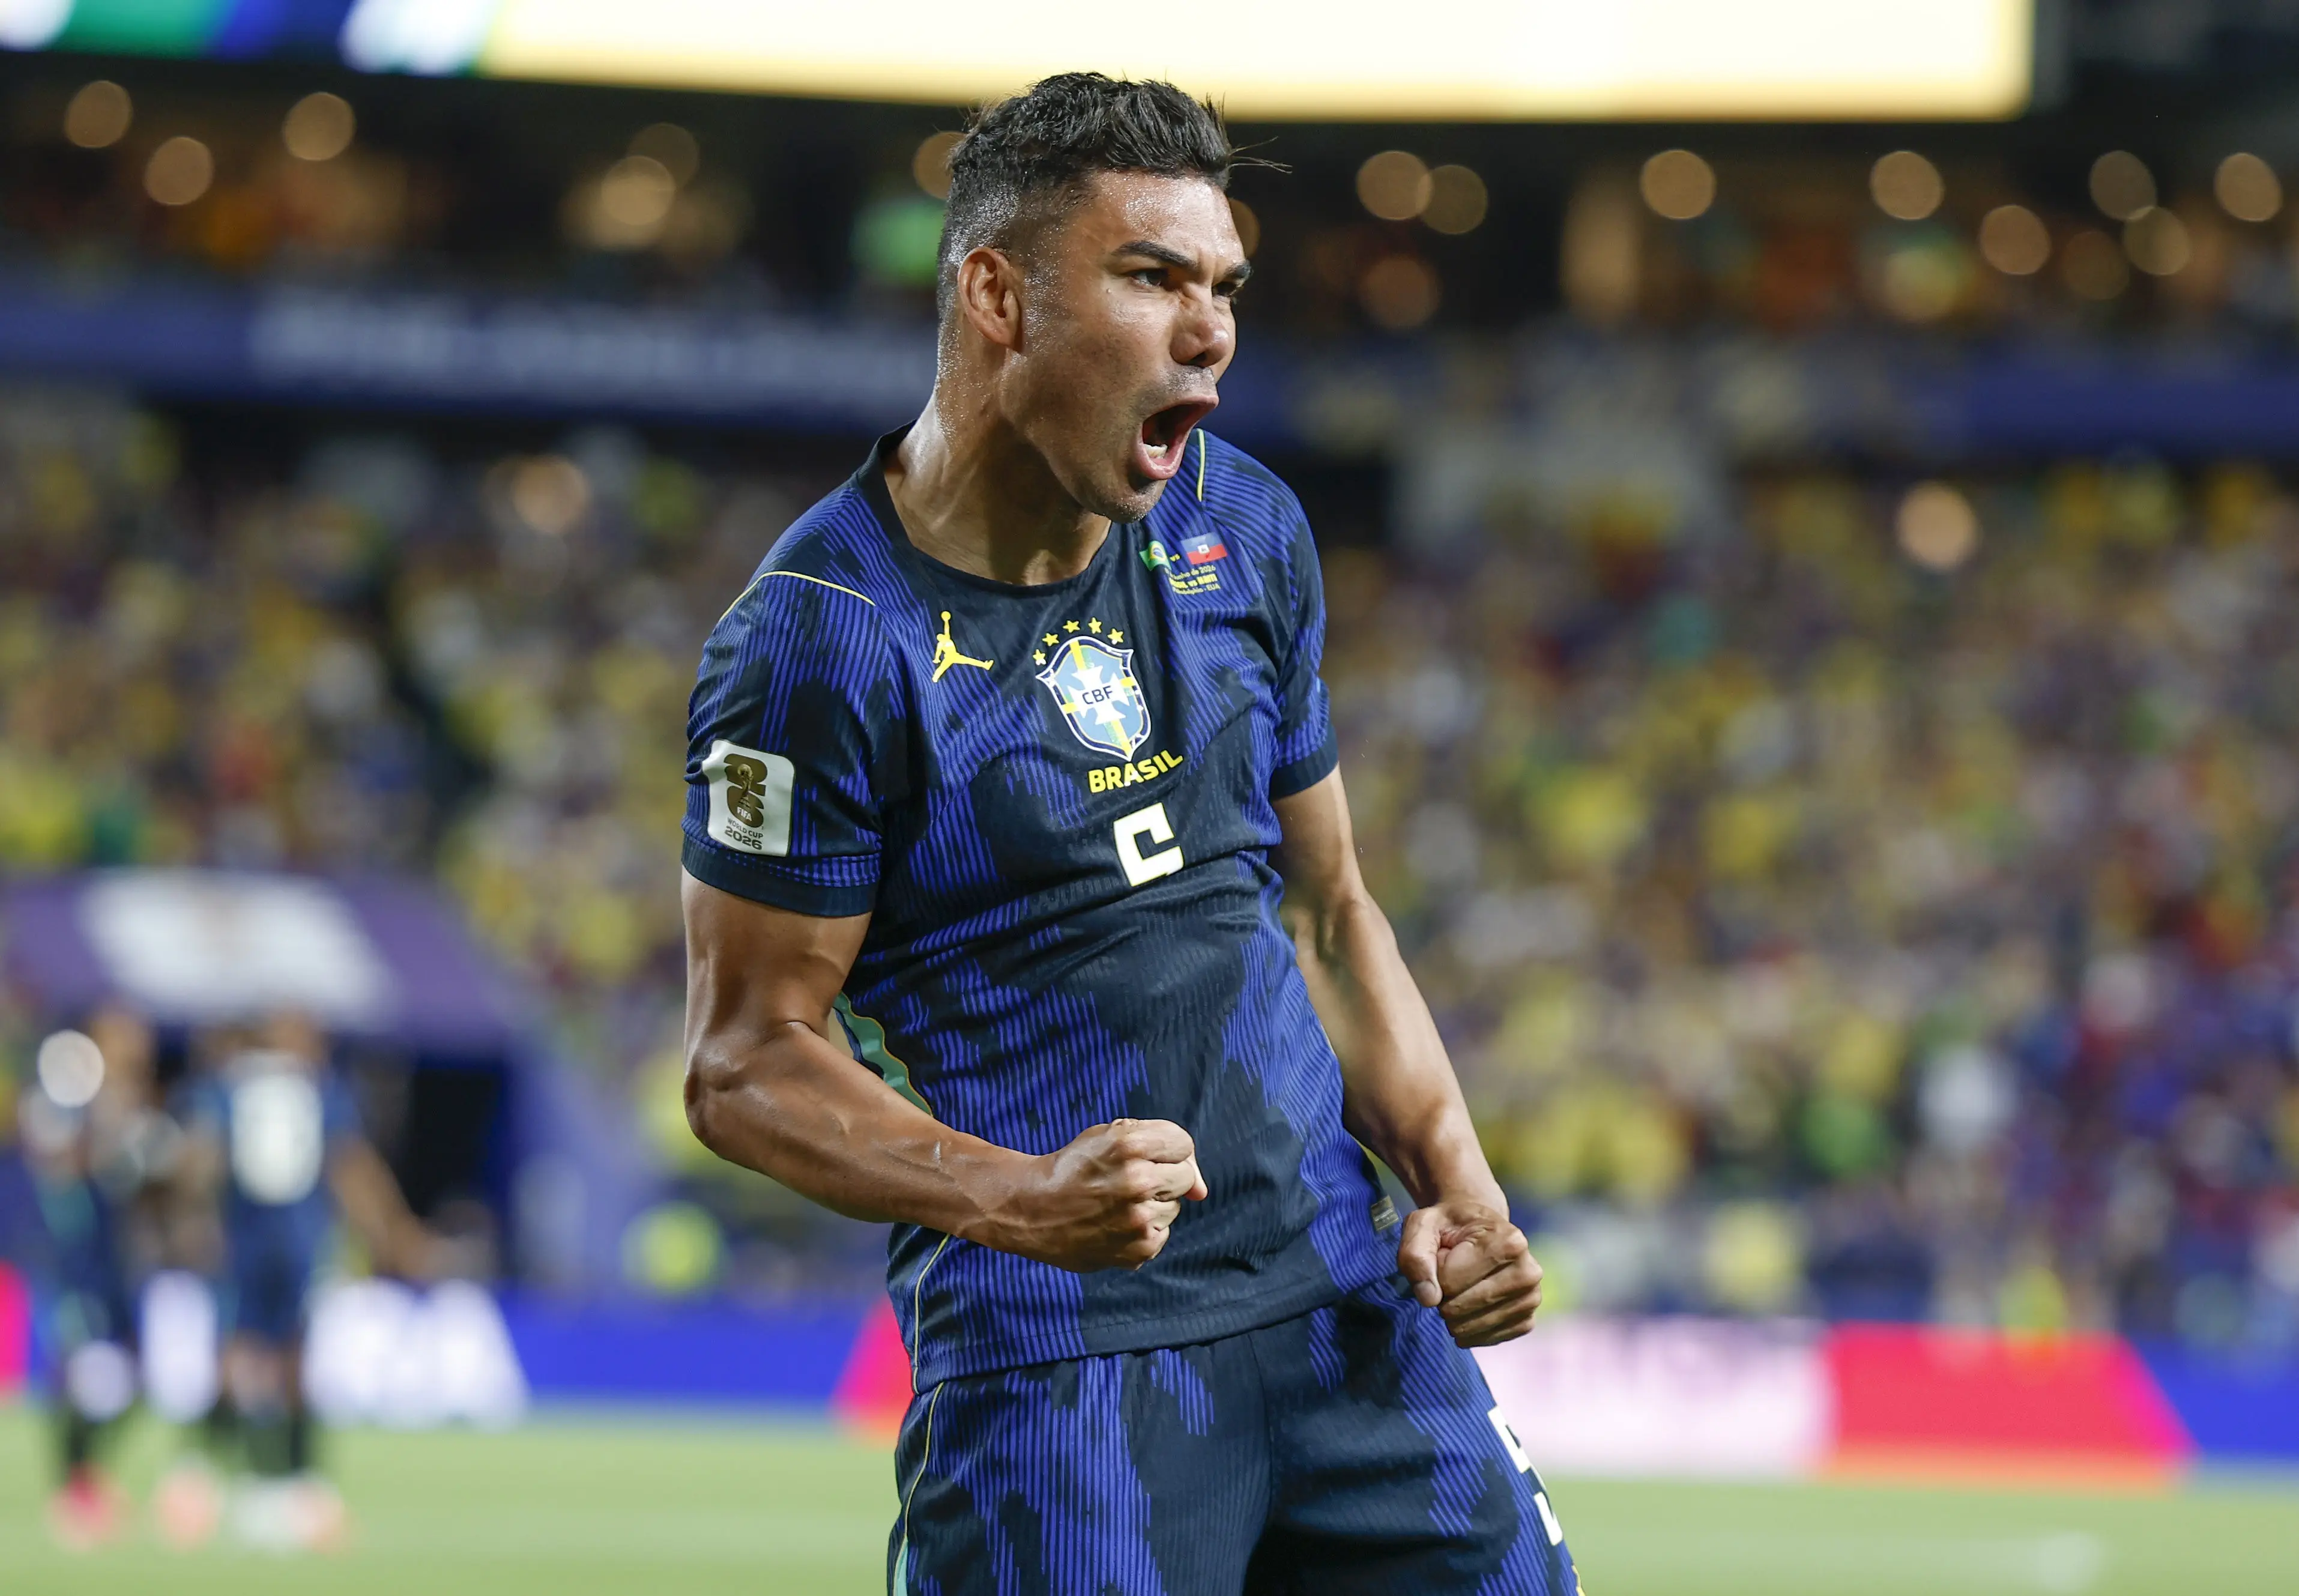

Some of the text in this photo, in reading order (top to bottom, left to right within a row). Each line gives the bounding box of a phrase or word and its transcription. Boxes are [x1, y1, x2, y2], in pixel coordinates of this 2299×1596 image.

[1081, 686, 1114, 706] CBF
[1087, 749, 1183, 794] BRASIL
[737, 806, 752, 821] FIFA
[724, 826, 763, 850] 2026
[727, 817, 763, 839] WORLD CUP
